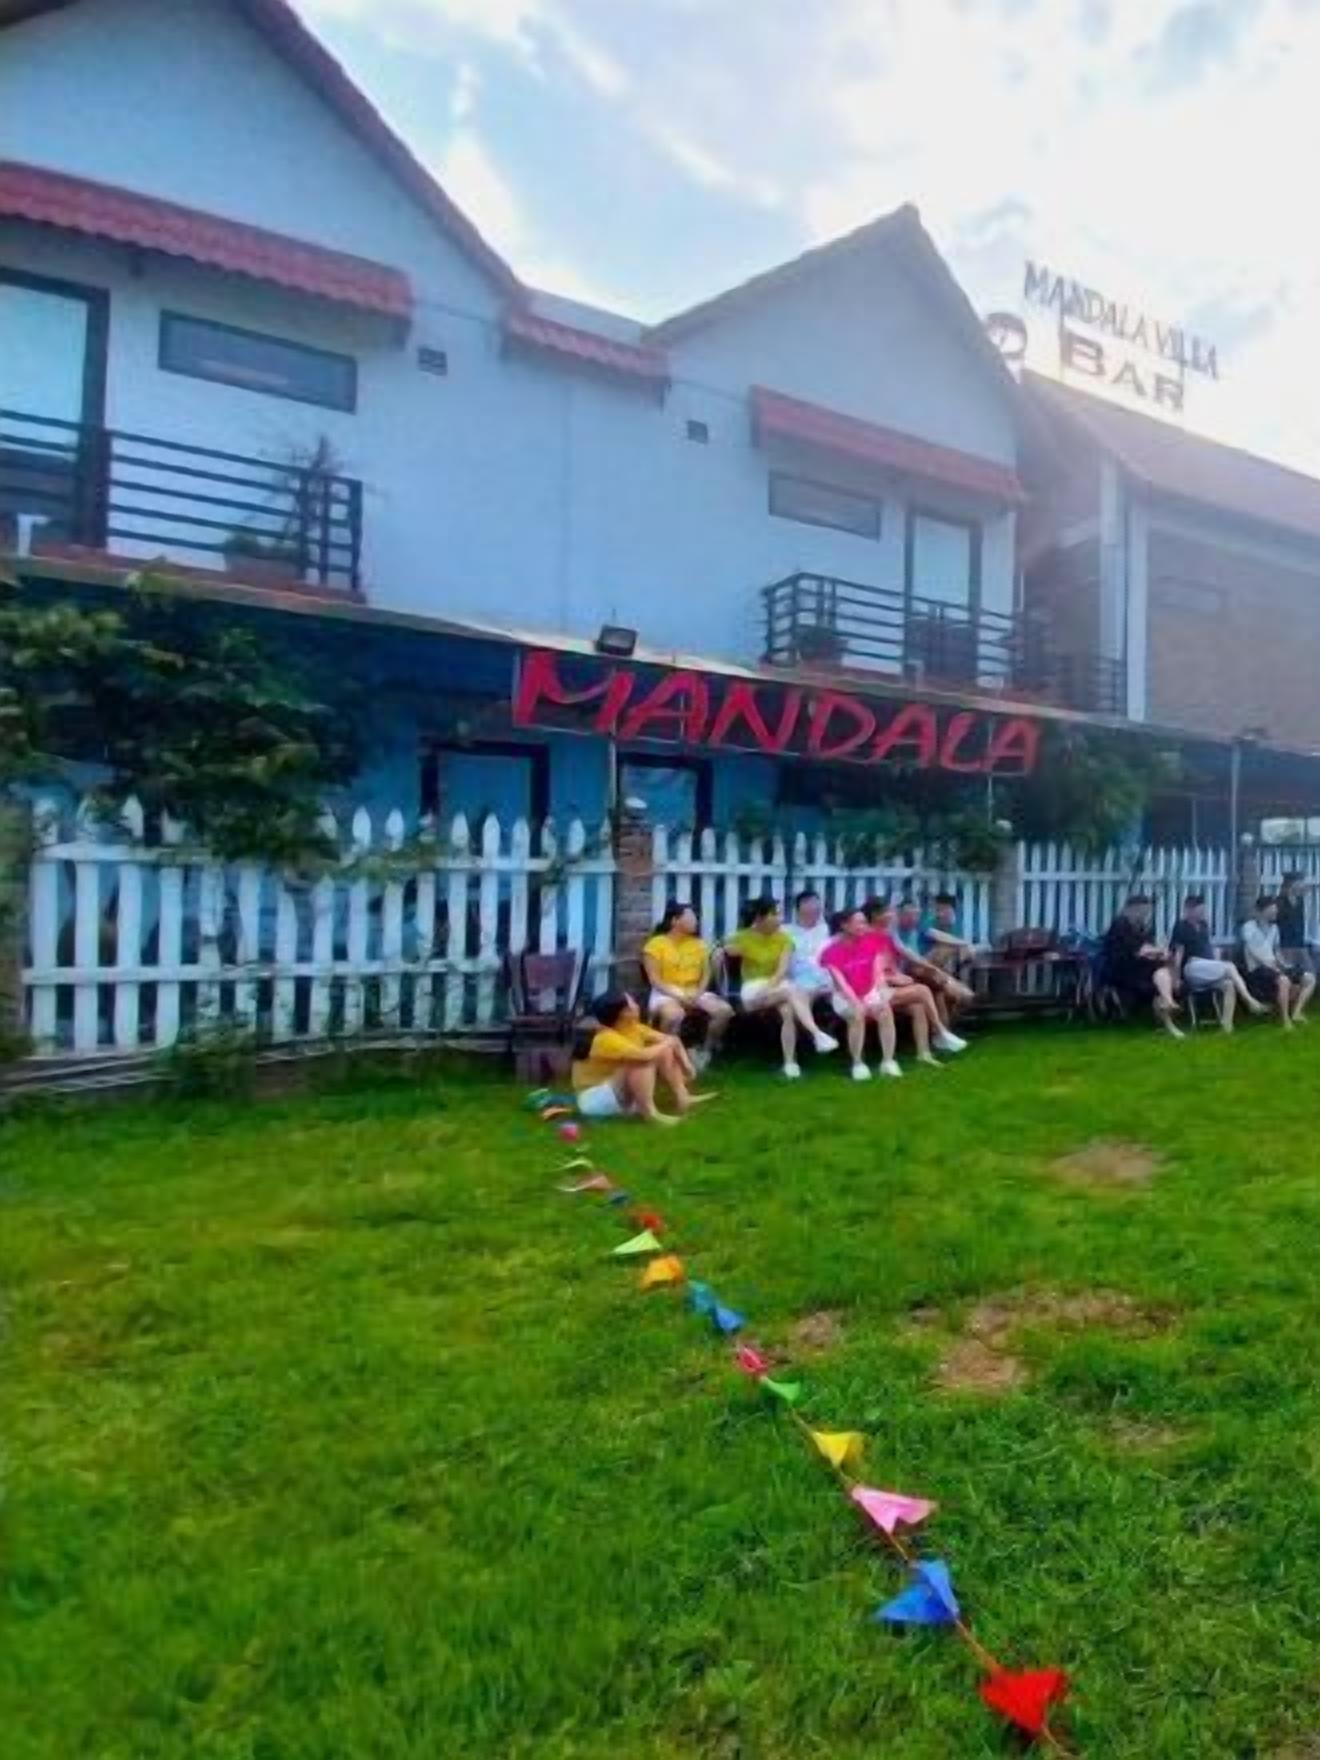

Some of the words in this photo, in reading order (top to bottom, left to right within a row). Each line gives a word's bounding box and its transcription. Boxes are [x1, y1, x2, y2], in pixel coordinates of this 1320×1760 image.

[1024, 260, 1148, 349] MANDALA
[1155, 318, 1219, 381] VILLA
[1060, 330, 1184, 411] BAR
[513, 650, 1040, 775] MANDALA
